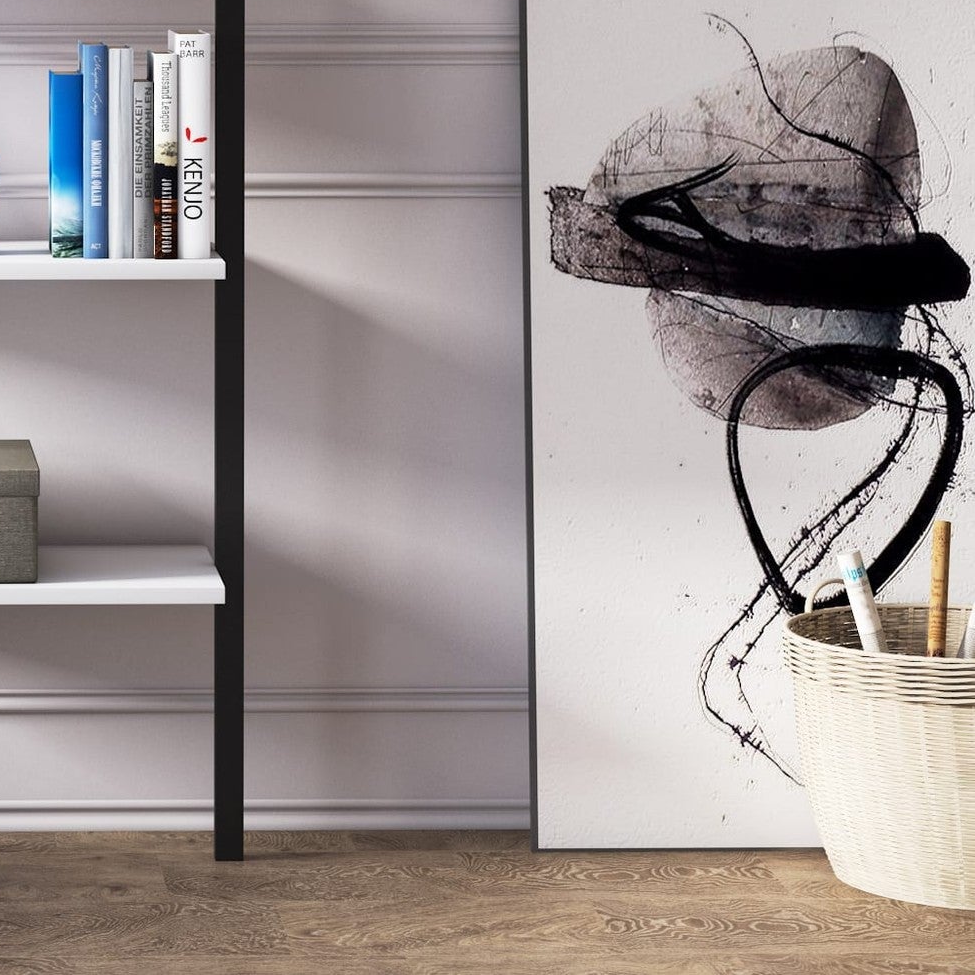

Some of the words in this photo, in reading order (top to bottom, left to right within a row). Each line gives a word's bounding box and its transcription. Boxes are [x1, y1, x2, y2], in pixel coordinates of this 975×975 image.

[179, 40, 196, 49] PAT
[179, 50, 205, 58] BARR
[161, 60, 172, 99] Thousand
[144, 86, 153, 170] PRIMZAHLEN
[160, 101, 172, 133] Leagues
[135, 97, 143, 174] EINSAMKEIT
[135, 176, 143, 198] DIE
[161, 178, 172, 213] JONATHAN
[184, 158, 203, 220] KENJO
